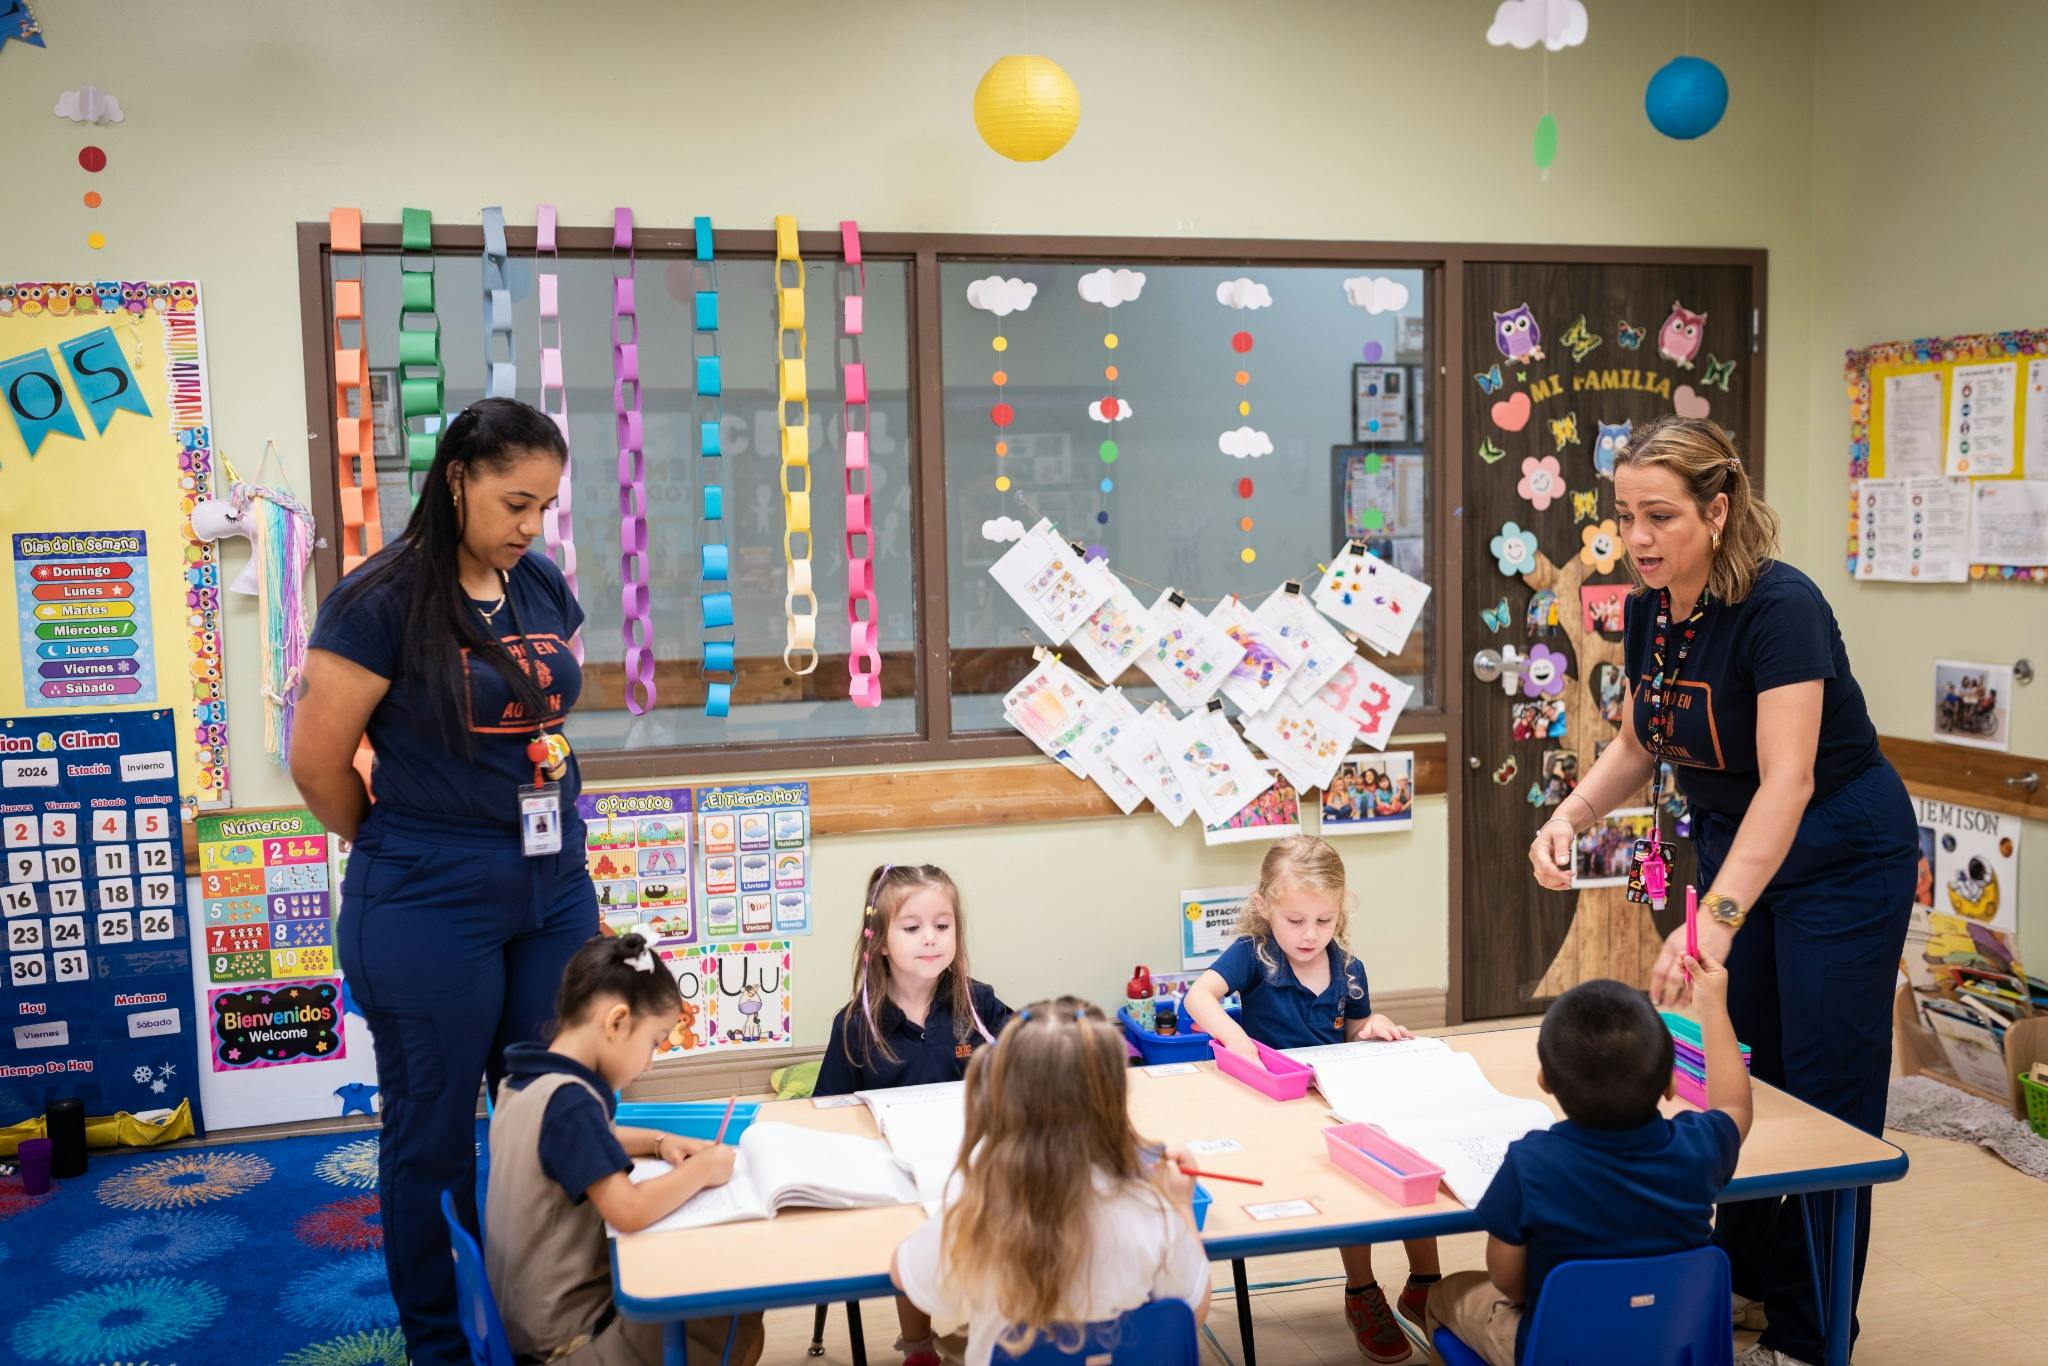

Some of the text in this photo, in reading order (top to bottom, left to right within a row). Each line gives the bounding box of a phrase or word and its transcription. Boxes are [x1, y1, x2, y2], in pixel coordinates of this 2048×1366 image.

[1529, 374, 1564, 403] MI
[23, 537, 137, 554] Días de la Semana
[53, 566, 111, 577] Domingo
[64, 586, 103, 596] Lunes
[61, 605, 108, 616] Martes
[54, 623, 118, 636] Miércoles
[65, 645, 110, 655] Jueves
[63, 664, 114, 674] Viernes
[65, 681, 115, 694] Sábado
[1677, 693, 1692, 710] EN
[38, 733, 56, 749] &
[61, 731, 118, 748] Clima
[17, 767, 48, 777] 2026
[127, 762, 164, 772] Invierno
[0, 804, 33, 812] Jueves
[46, 802, 80, 810] Viernes
[135, 795, 172, 804] Domingo
[708, 794, 722, 806] El
[775, 789, 800, 802] Hoy
[1919, 798, 2000, 835] JEMISON
[15, 816, 158, 841] 2 3 4 5
[222, 819, 300, 836] Números
[206, 842, 283, 863] 1 2
[19, 850, 167, 876] 9 10 11 12
[208, 870, 283, 892] 3 4
[6, 883, 169, 909] 16 17 18 19
[210, 897, 286, 918] 5 6
[13, 916, 170, 944] 23 24 25 26
[213, 924, 287, 946] 7 8
[14, 957, 83, 979] 30 31
[215, 950, 297, 973] 9 10
[115, 993, 166, 1005] Mañana
[19, 1003, 46, 1014] Hoy
[136, 1018, 172, 1029] Sábado
[224, 1005, 332, 1030] Bienvenidos
[23, 1029, 60, 1039] Viernes
[249, 1028, 308, 1042] Welcome
[47, 1062, 65, 1073] De
[68, 1060, 93, 1073] Hoy
